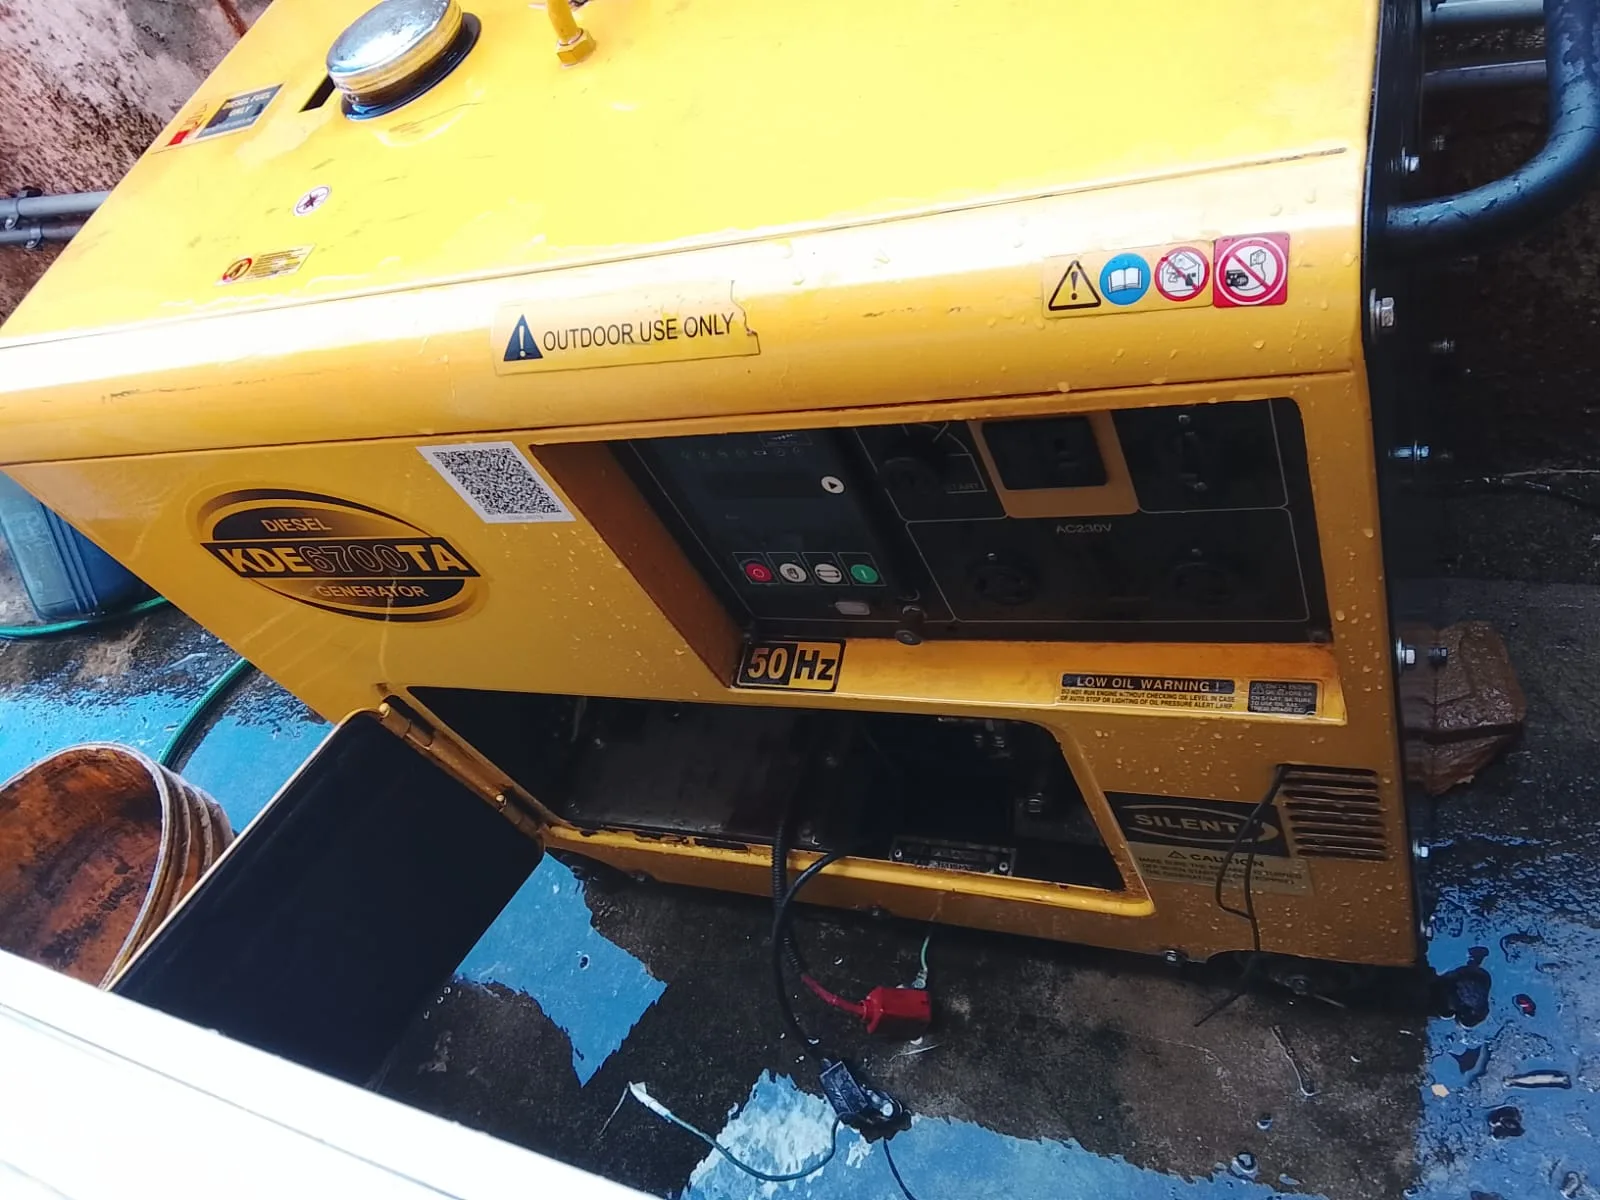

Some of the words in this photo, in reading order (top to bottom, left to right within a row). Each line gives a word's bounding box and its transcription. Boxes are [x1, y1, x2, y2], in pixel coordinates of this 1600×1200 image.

[543, 323, 635, 351] OUTDOOR
[640, 318, 678, 342] USE
[684, 312, 734, 338] ONLY
[261, 517, 333, 532] DIESEL
[1056, 522, 1112, 535] AC230V
[219, 543, 470, 574] KDE6700TA
[315, 585, 430, 599] GENERATOR
[747, 647, 788, 679] 50
[794, 649, 836, 680] Hz
[1077, 677, 1107, 688] LOW
[1112, 678, 1134, 689] OIL
[1141, 679, 1210, 692] WARNING
[1134, 814, 1239, 834] SILENT
[1189, 854, 1264, 868] CAUION
